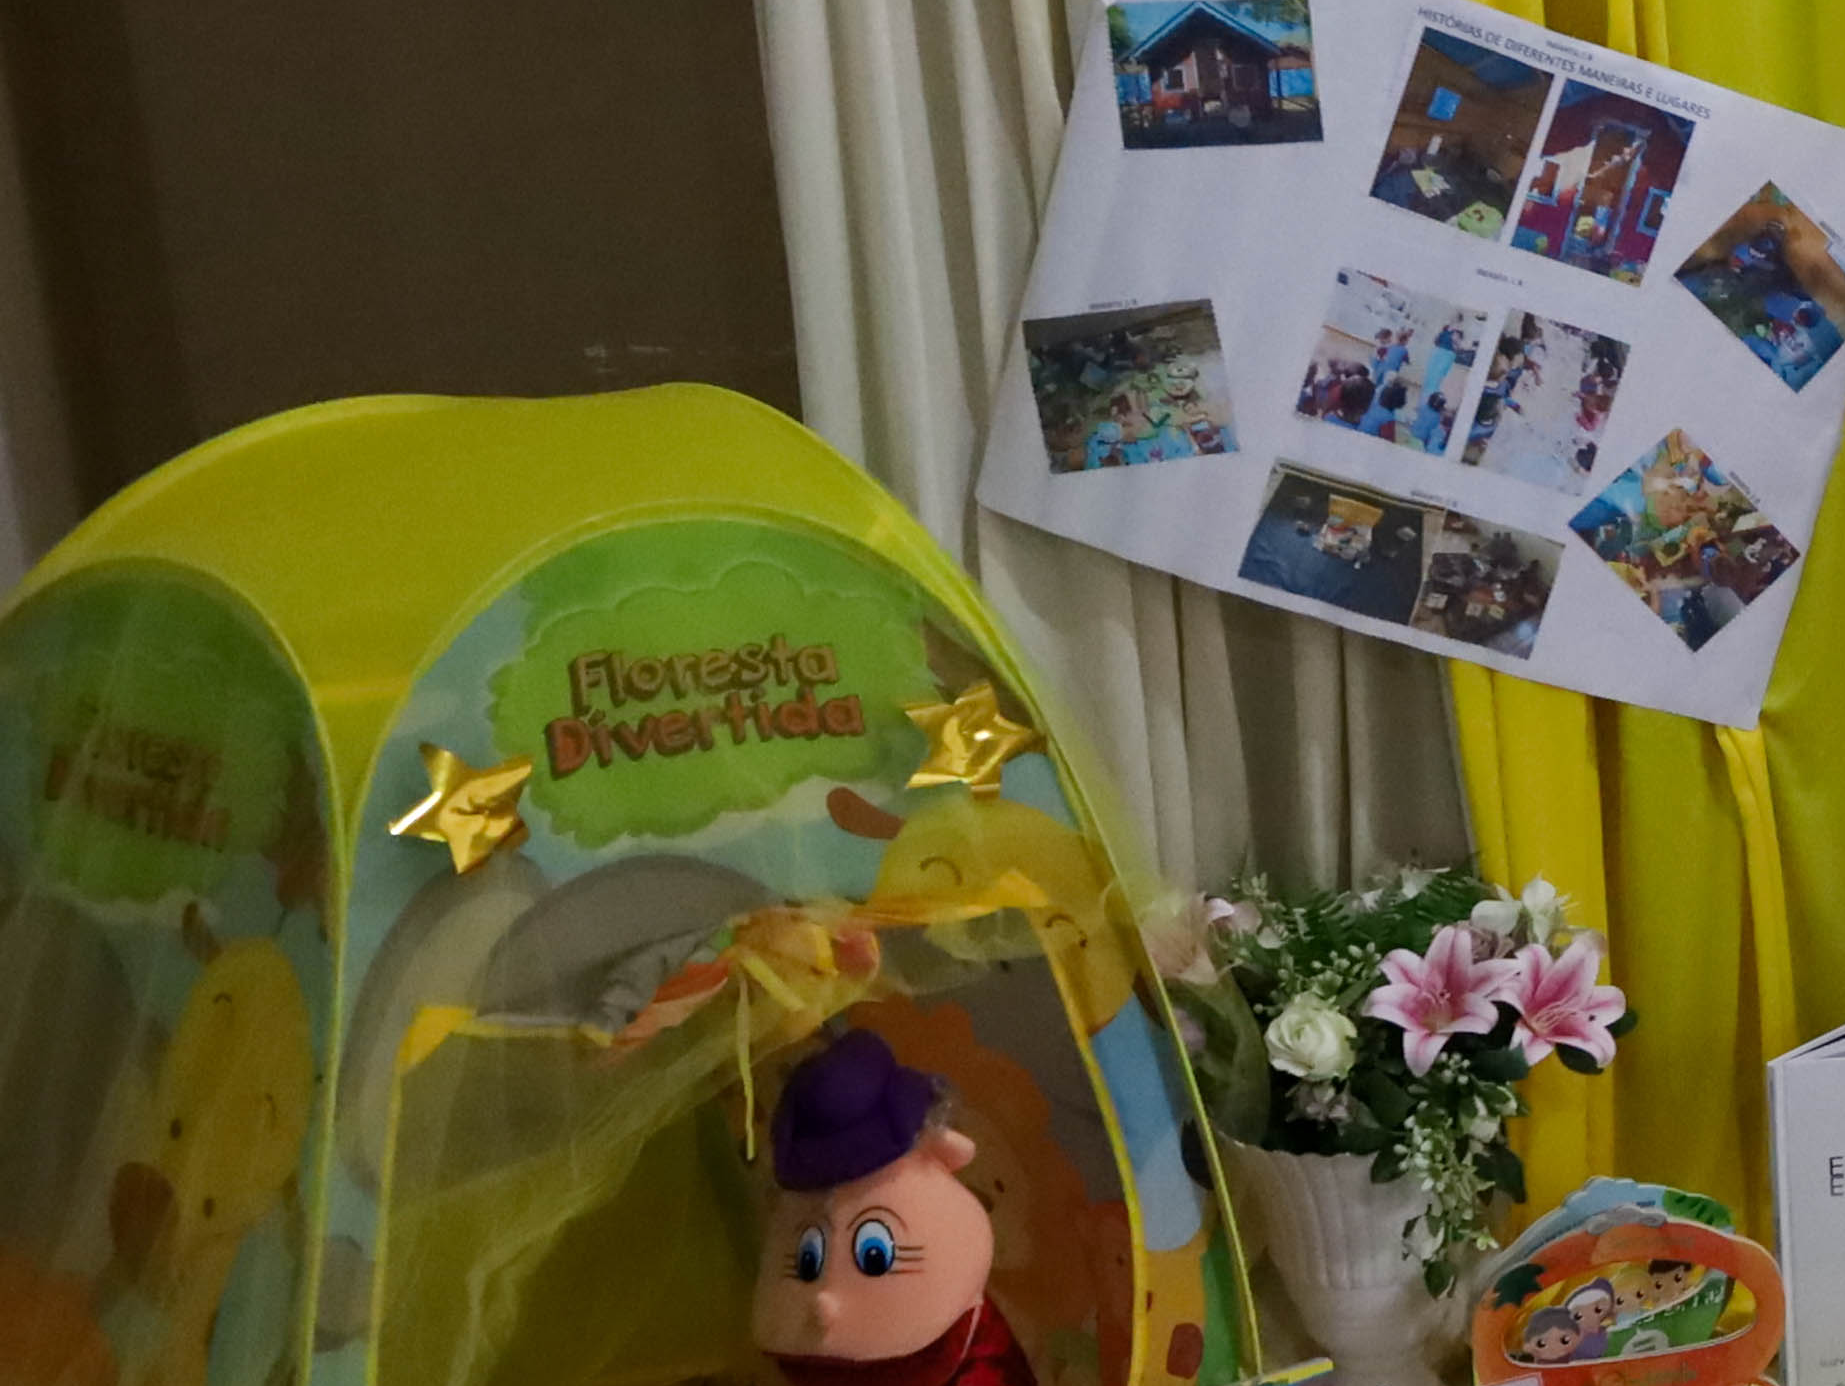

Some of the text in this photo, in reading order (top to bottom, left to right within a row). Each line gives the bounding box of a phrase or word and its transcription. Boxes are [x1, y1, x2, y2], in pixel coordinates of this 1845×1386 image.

[1416, 6, 1711, 120] HISTÓRIAS DE DIFERENTES MANEIRAS E LUGARES
[569, 635, 841, 717] Floresta
[543, 684, 866, 778] Divertida
